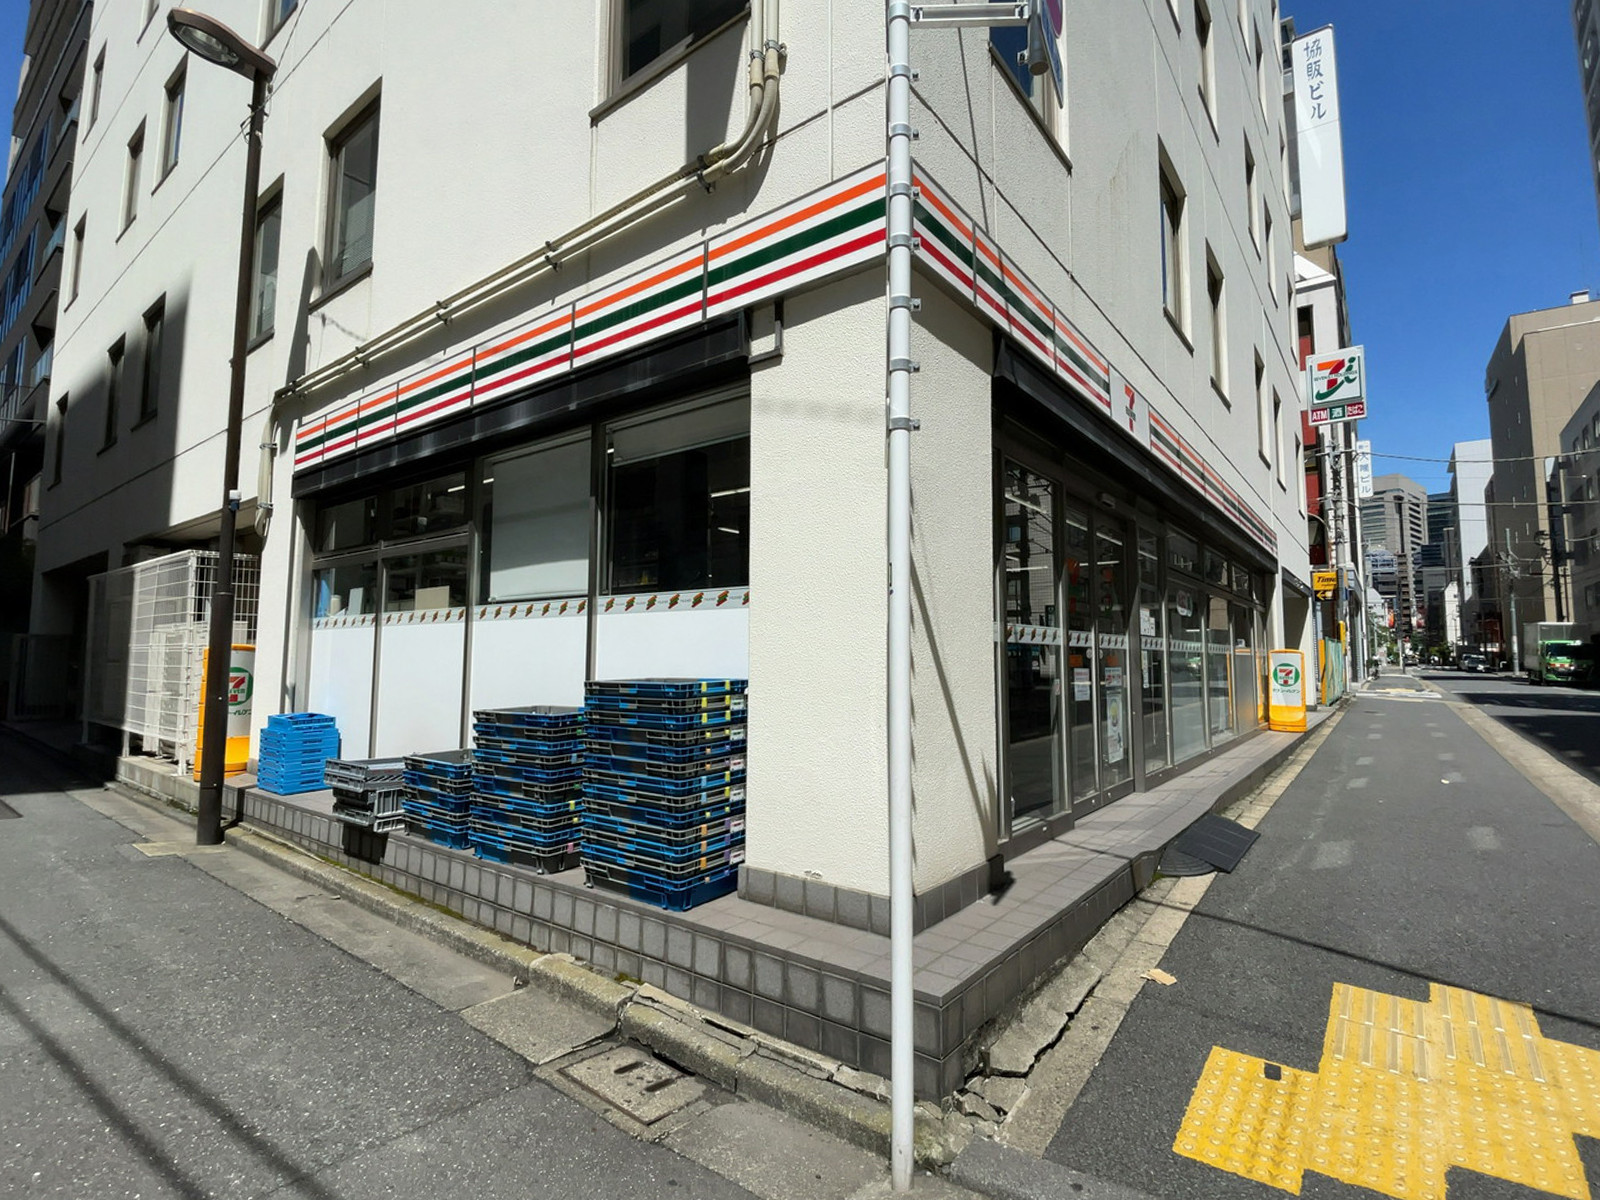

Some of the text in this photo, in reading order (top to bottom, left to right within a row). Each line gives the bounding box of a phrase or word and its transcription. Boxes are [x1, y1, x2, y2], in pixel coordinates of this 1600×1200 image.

[1303, 37, 1327, 121] 協販ビル
[1312, 410, 1328, 422] ATM
